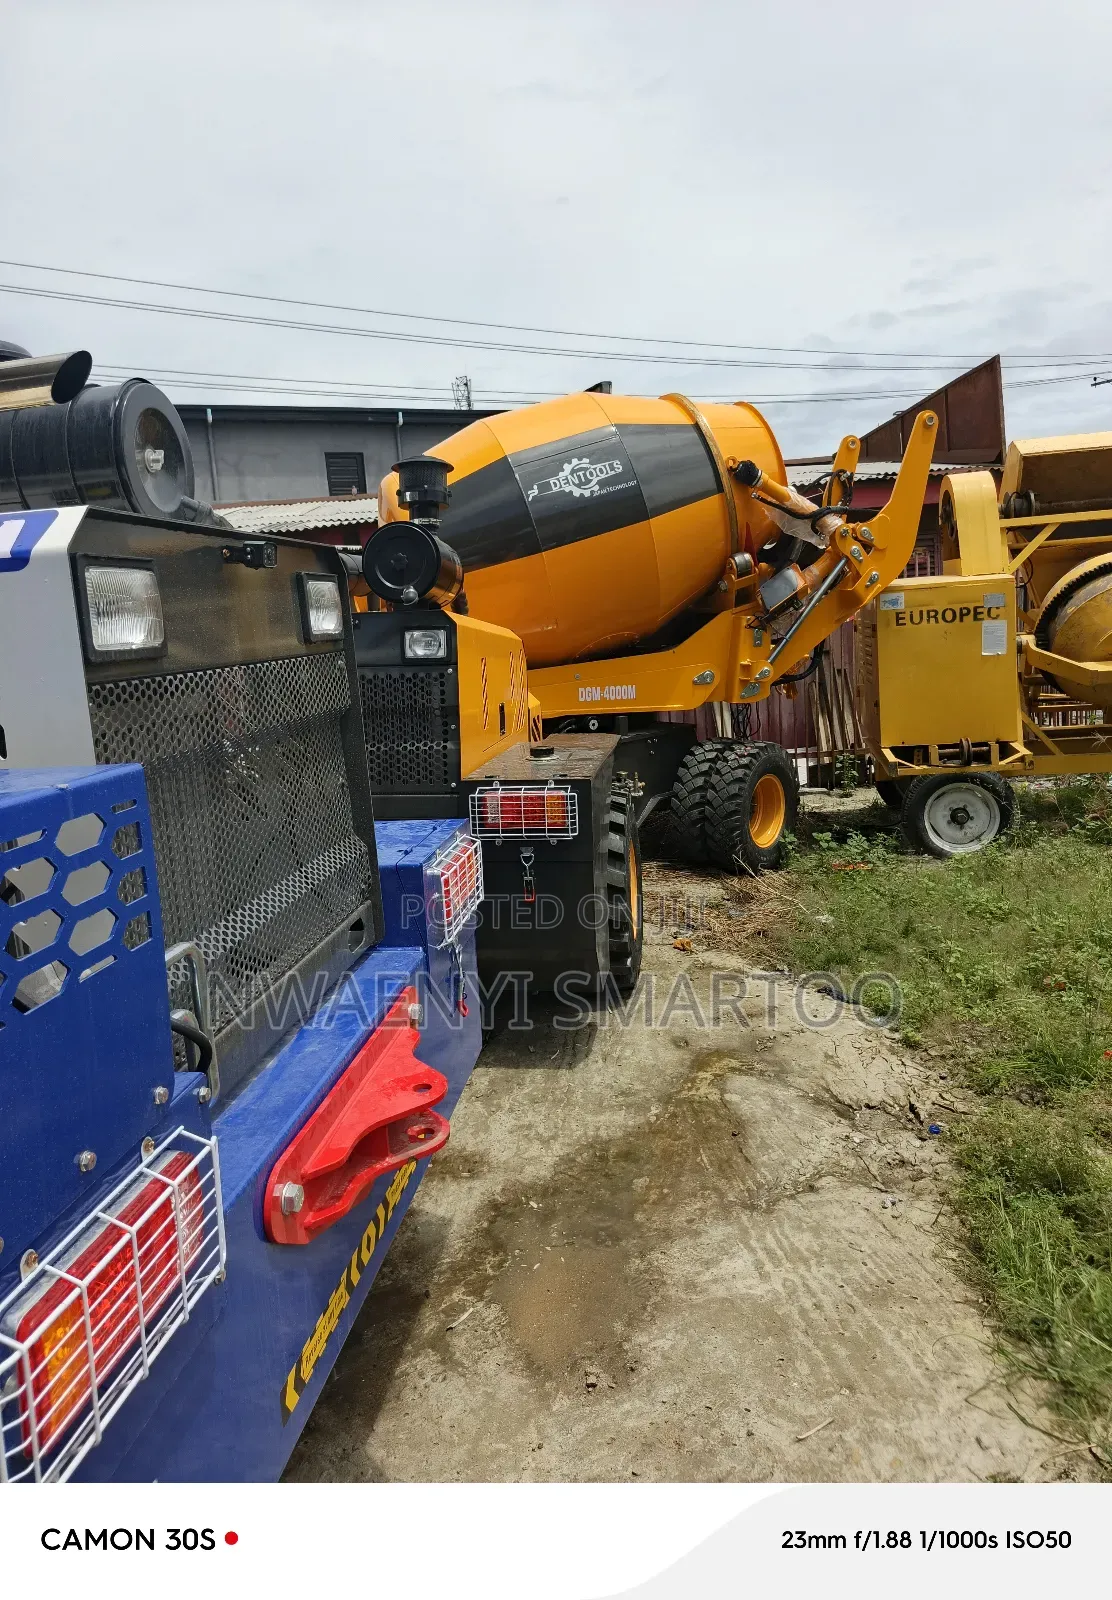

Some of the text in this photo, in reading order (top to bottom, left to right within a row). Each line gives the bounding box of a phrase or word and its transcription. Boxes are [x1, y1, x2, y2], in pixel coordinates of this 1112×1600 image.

[550, 461, 623, 491] DENTOOLS
[607, 480, 637, 494] TECHNOLOGY
[895, 605, 1001, 627] EUROPEC
[578, 685, 636, 702] DGM-4000M
